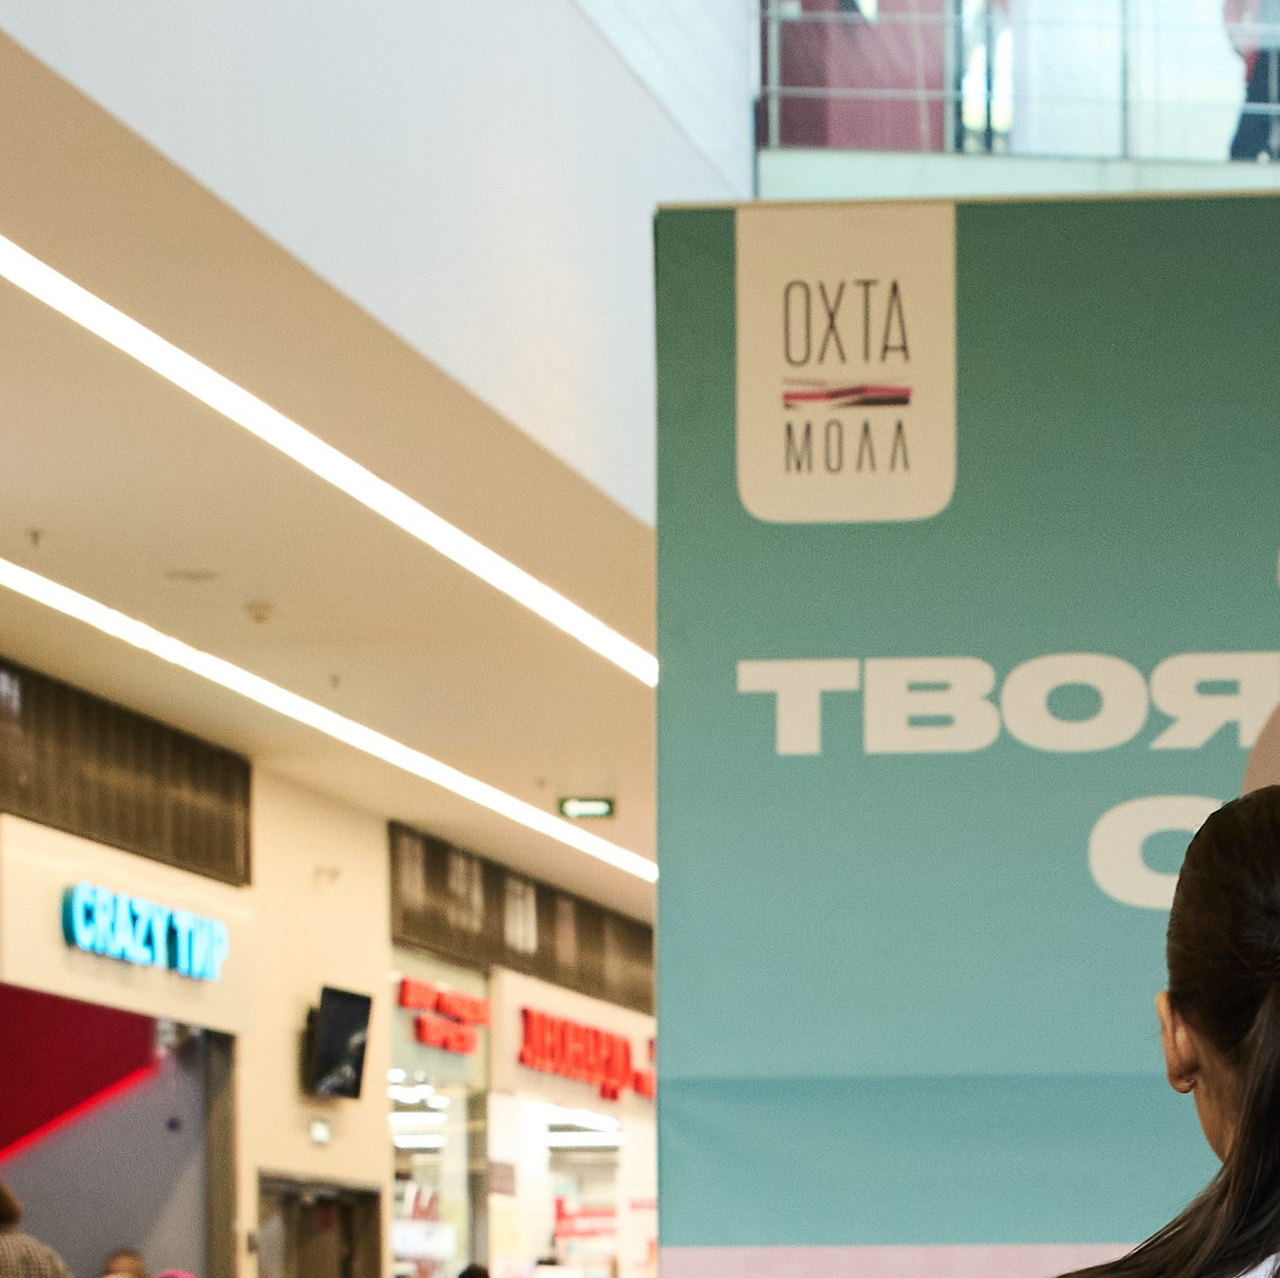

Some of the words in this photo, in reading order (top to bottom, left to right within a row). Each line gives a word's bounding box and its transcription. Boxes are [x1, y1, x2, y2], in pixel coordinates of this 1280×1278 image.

[782, 279, 911, 367] ОХТА
[784, 418, 911, 475] МОЛЛ
[63, 881, 173, 970] CRAZY
